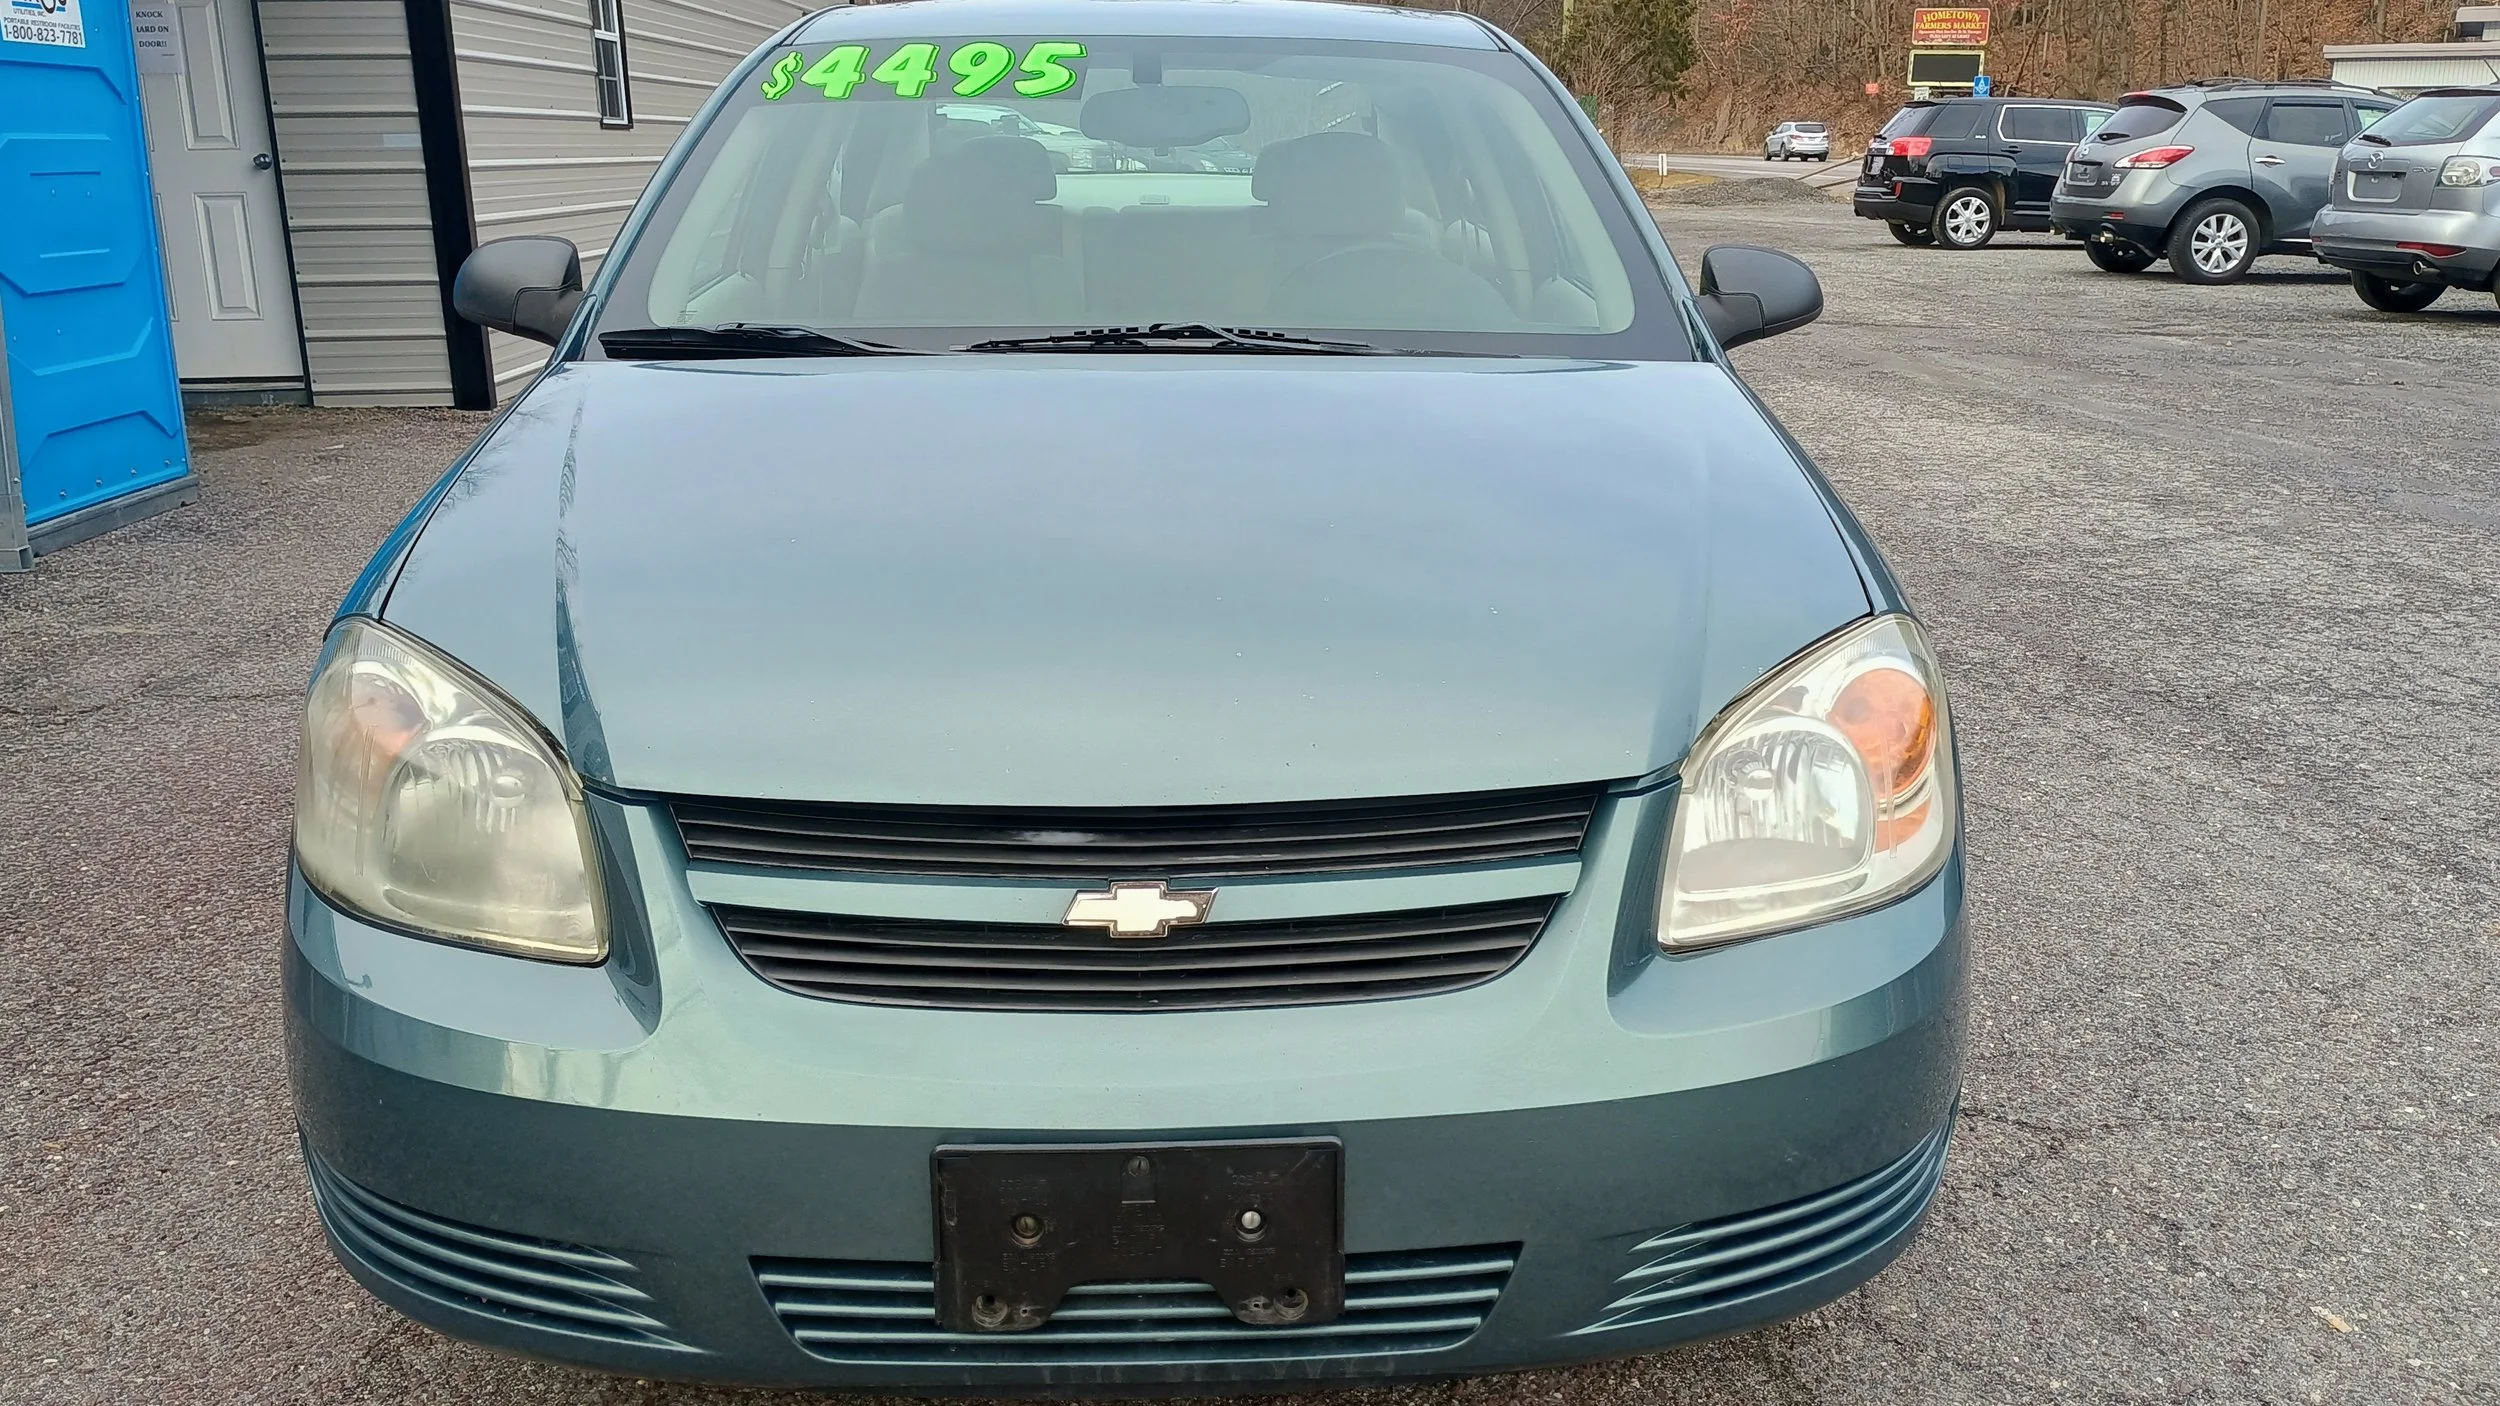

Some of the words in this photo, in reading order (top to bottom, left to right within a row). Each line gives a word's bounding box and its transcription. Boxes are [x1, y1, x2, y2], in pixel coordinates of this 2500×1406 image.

[4, 17, 29, 25] PORTABLE
[1922, 11, 1982, 23] HOMETOWN
[4, 24, 83, 45] 1-800-823-7781
[761, 41, 1087, 100] $4495
